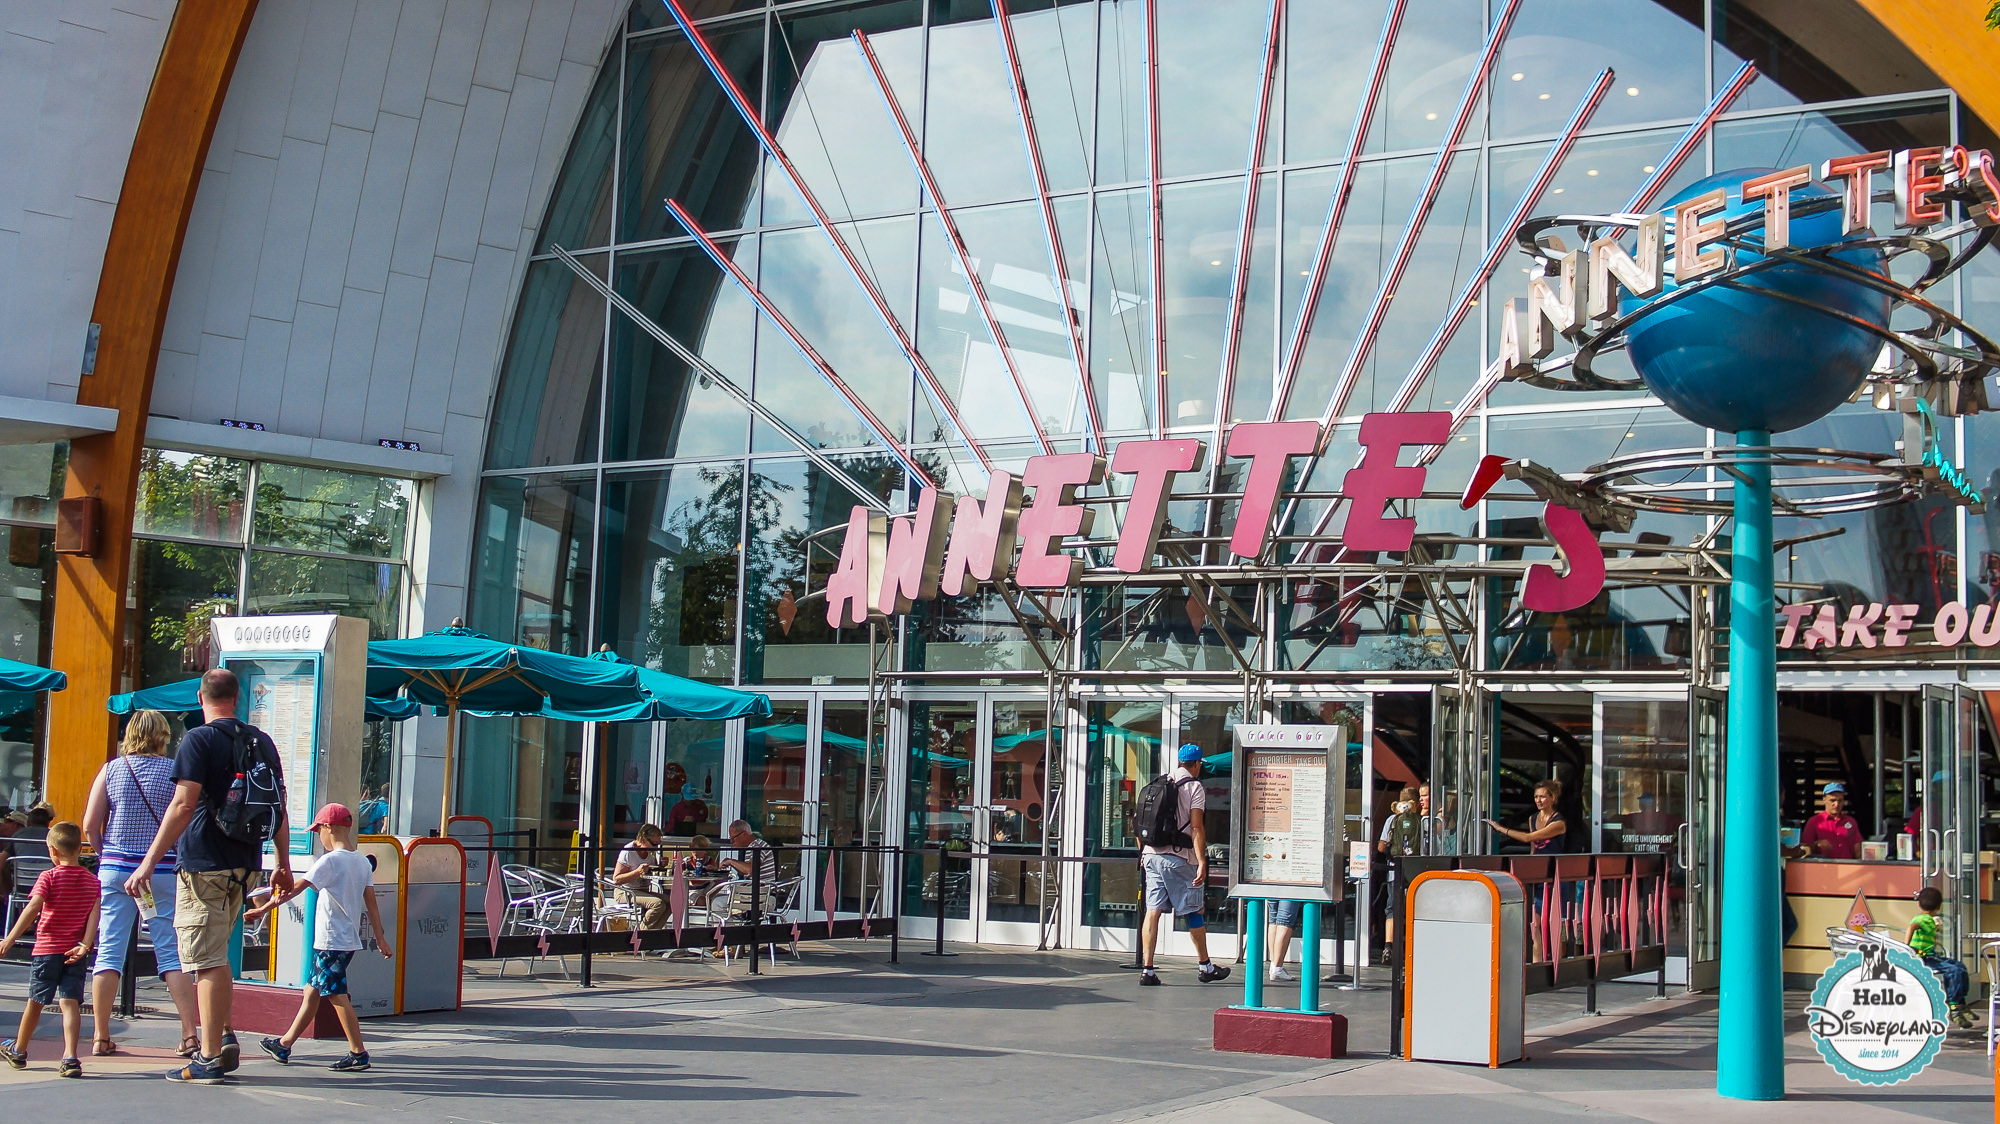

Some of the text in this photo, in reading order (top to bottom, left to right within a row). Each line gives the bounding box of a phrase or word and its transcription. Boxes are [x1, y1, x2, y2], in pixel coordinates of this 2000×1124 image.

[826, 411, 1606, 629] ANNETTE'S
[1780, 602, 1920, 649] TAKE
[1248, 731, 1323, 741] TAKE OUT
[1257, 755, 1292, 766] EMPORTER
[1295, 757, 1312, 767] TAKE
[1252, 771, 1274, 779] MENU
[1622, 834, 1673, 844] SORTIE UNIQUEMENT
[1634, 844, 1660, 853] EXIT ONLY
